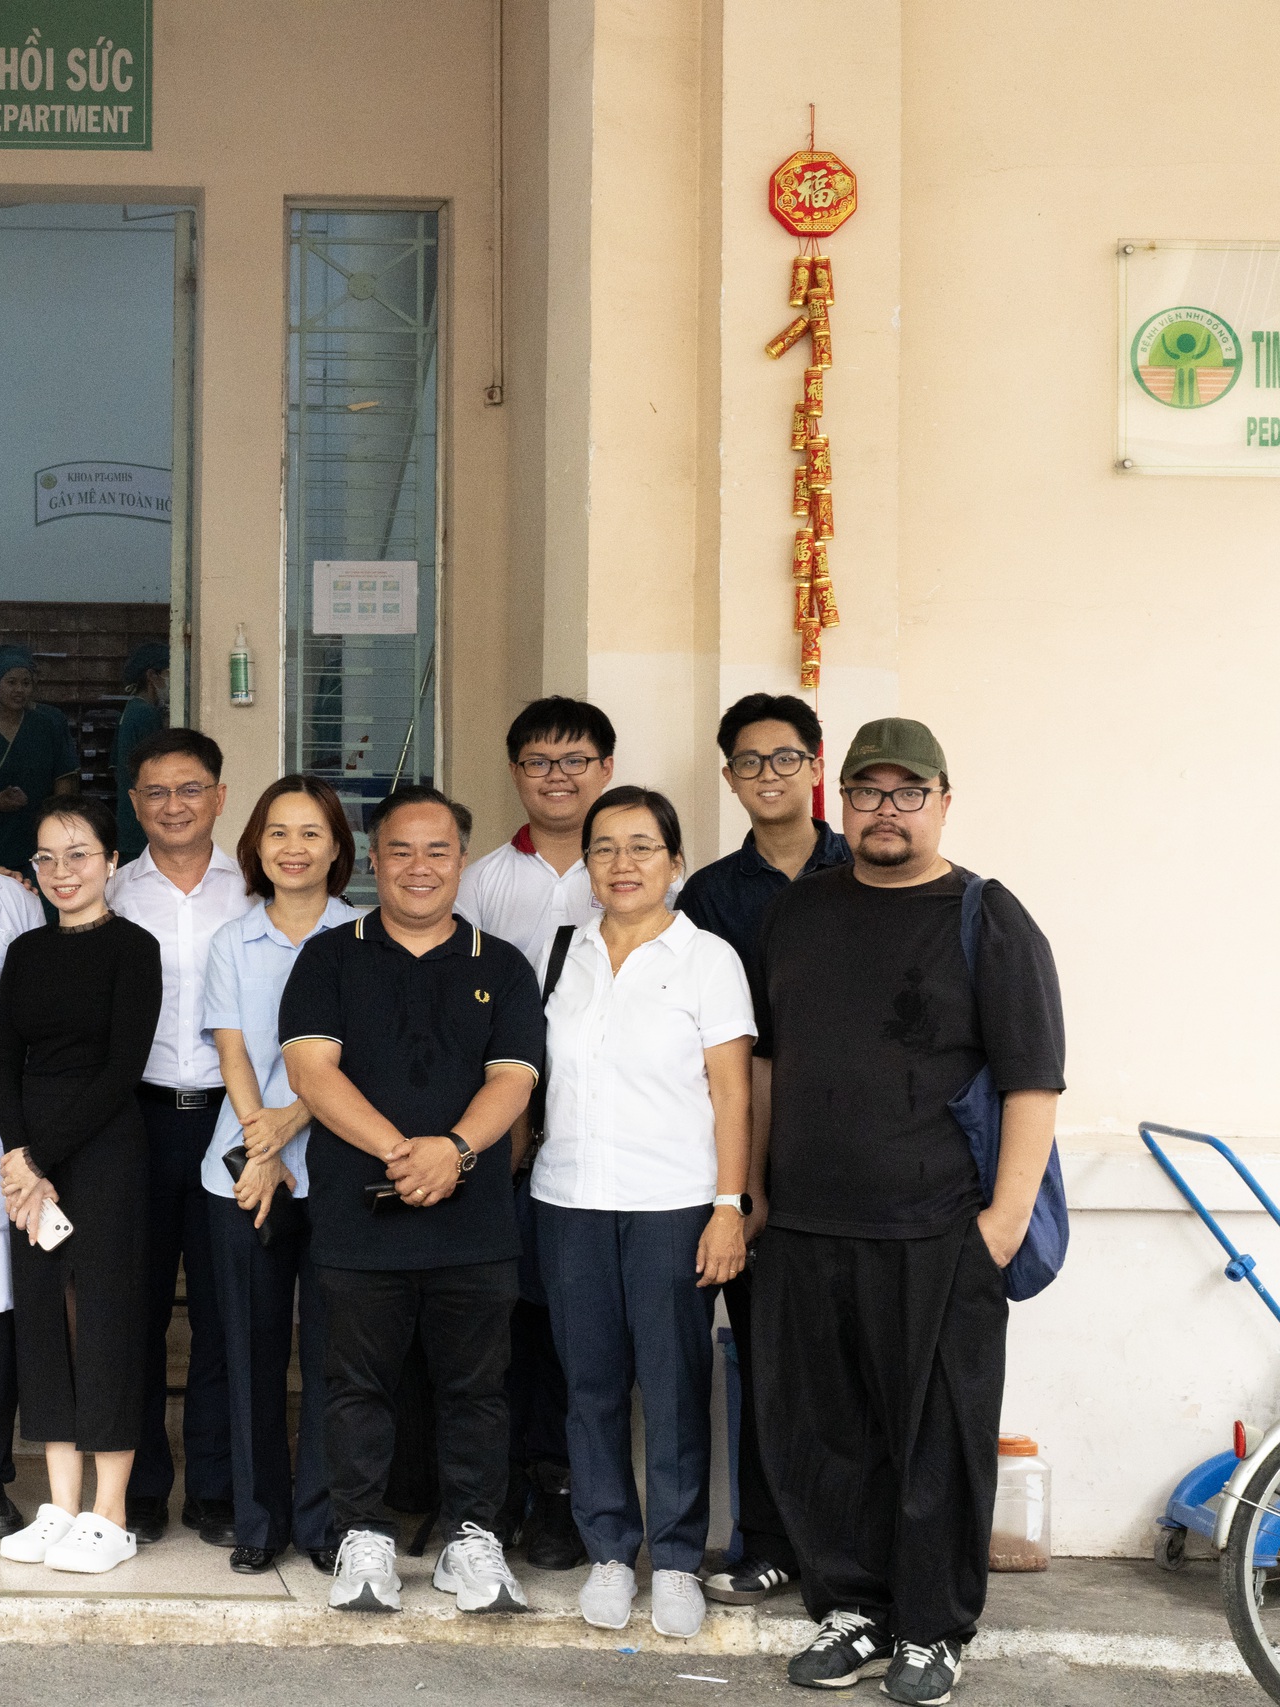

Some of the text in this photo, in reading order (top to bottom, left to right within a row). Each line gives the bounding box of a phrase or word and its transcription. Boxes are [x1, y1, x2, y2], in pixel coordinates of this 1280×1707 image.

[66, 36, 134, 92] SỨC
[796, 168, 835, 209] 福
[1185, 311, 1205, 322] NHI
[1246, 416, 1280, 447] PED
[67, 472, 133, 482] KHOA PT-GMHS
[48, 490, 76, 510] GÂY
[77, 487, 96, 504] MÊ
[98, 491, 116, 504] AN
[118, 491, 153, 509] TOÀN
